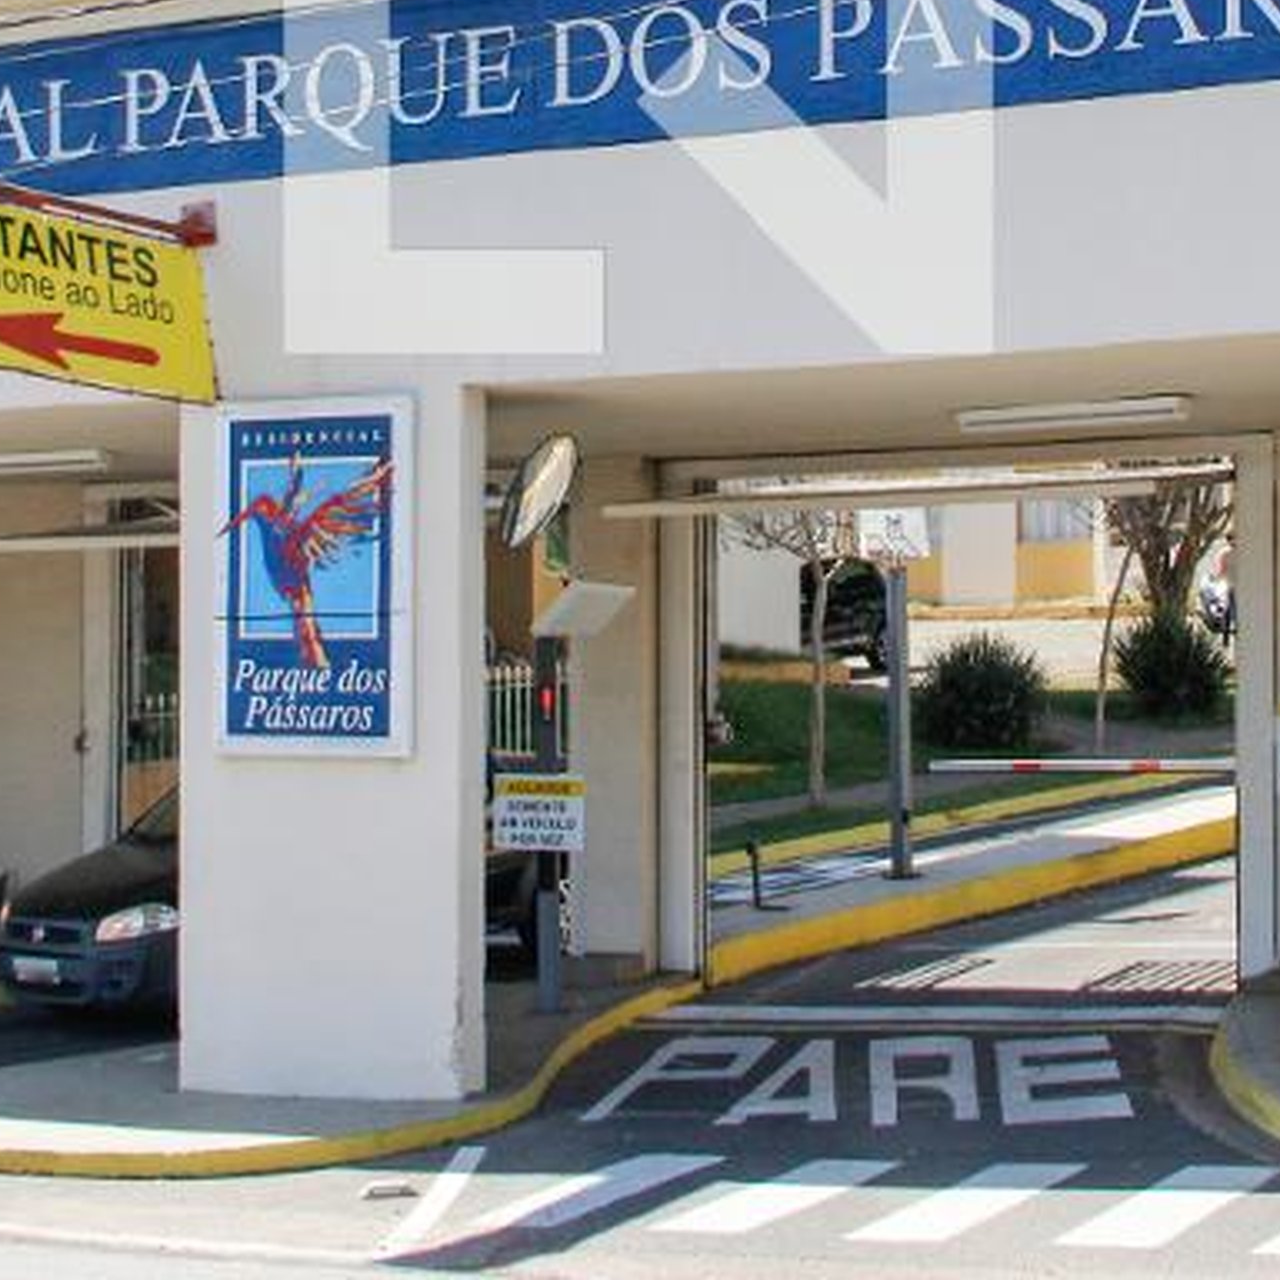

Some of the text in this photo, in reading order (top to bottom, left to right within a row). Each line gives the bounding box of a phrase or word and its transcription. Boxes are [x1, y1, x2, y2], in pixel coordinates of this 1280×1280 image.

[119, 24, 523, 153] PARQUE
[66, 280, 100, 308] ao
[108, 282, 175, 324] Lado
[235, 659, 387, 703] Parque dos
[244, 696, 375, 731] Pássaros
[577, 1034, 1134, 1127] PARE
